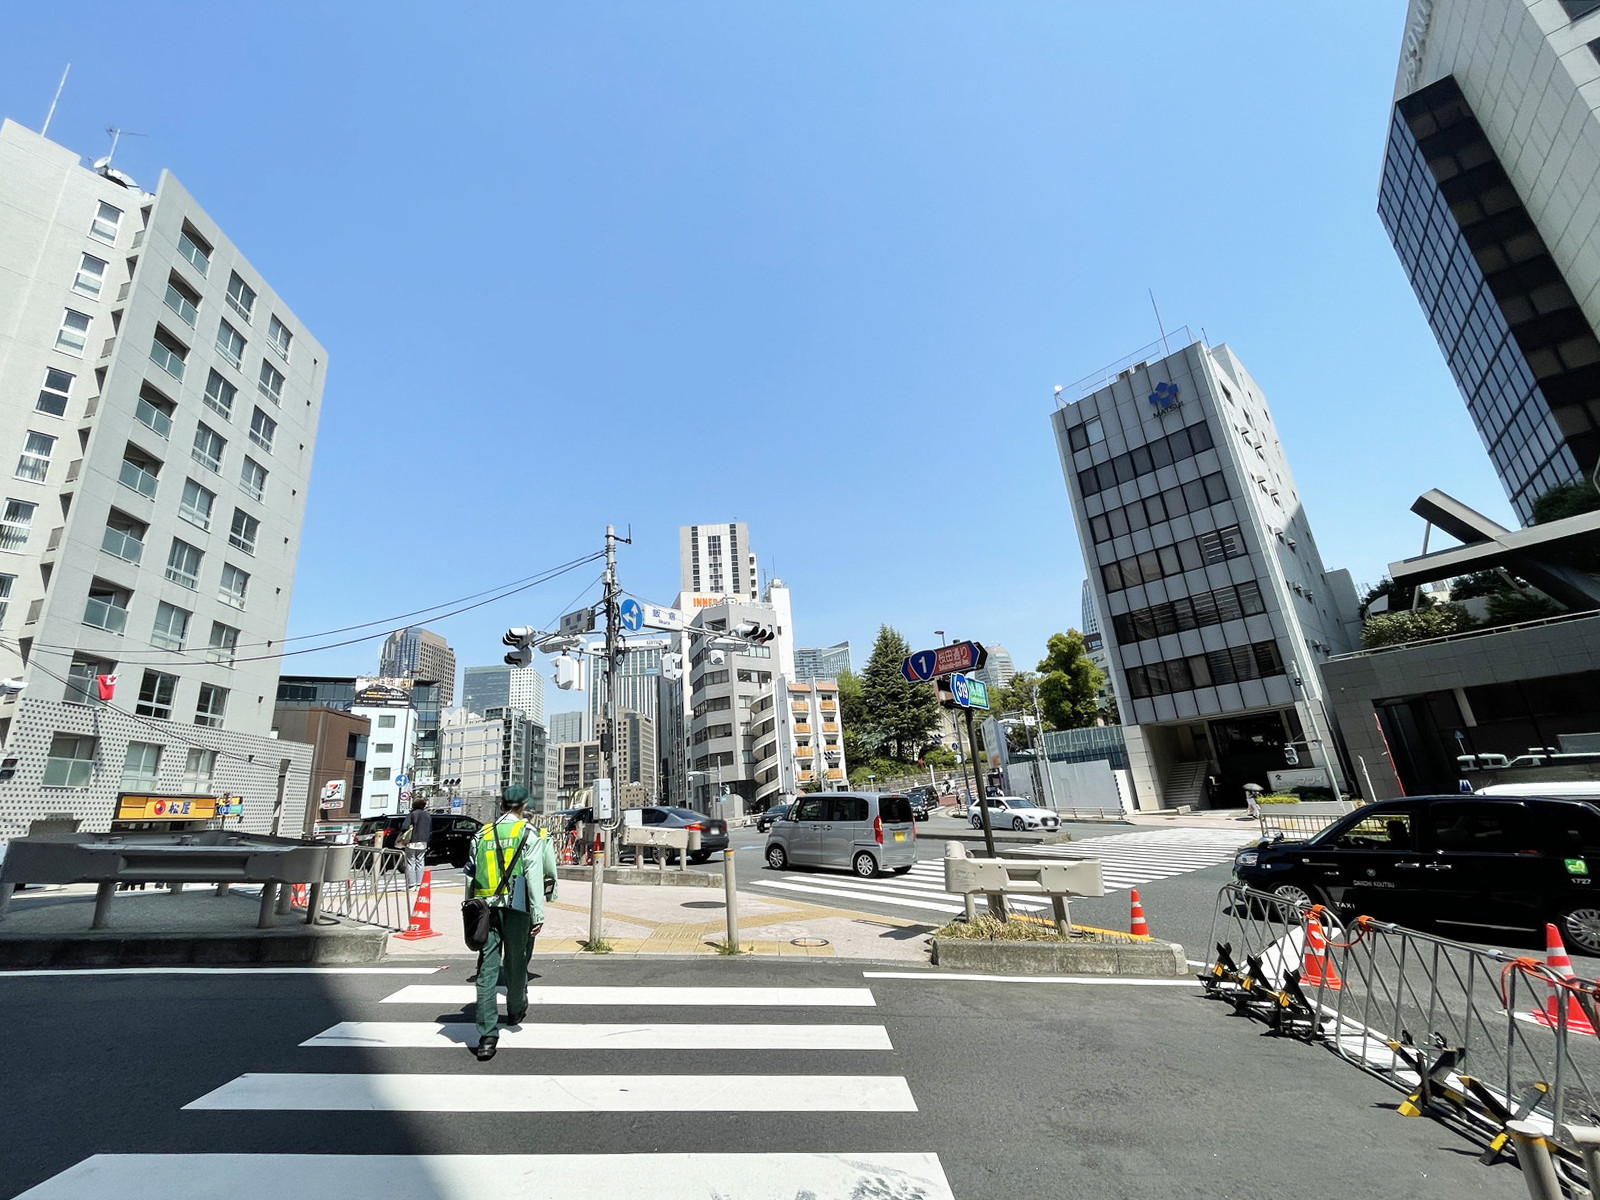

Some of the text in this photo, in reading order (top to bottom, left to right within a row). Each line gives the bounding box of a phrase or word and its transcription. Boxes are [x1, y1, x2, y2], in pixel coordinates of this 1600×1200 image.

[1153, 401, 1184, 418] MATSUI
[938, 646, 968, 664] 桜田通り
[919, 656, 927, 673] 1
[957, 681, 969, 699] 319
[168, 801, 191, 815] 松屋
[1335, 901, 1355, 909] TAXI
